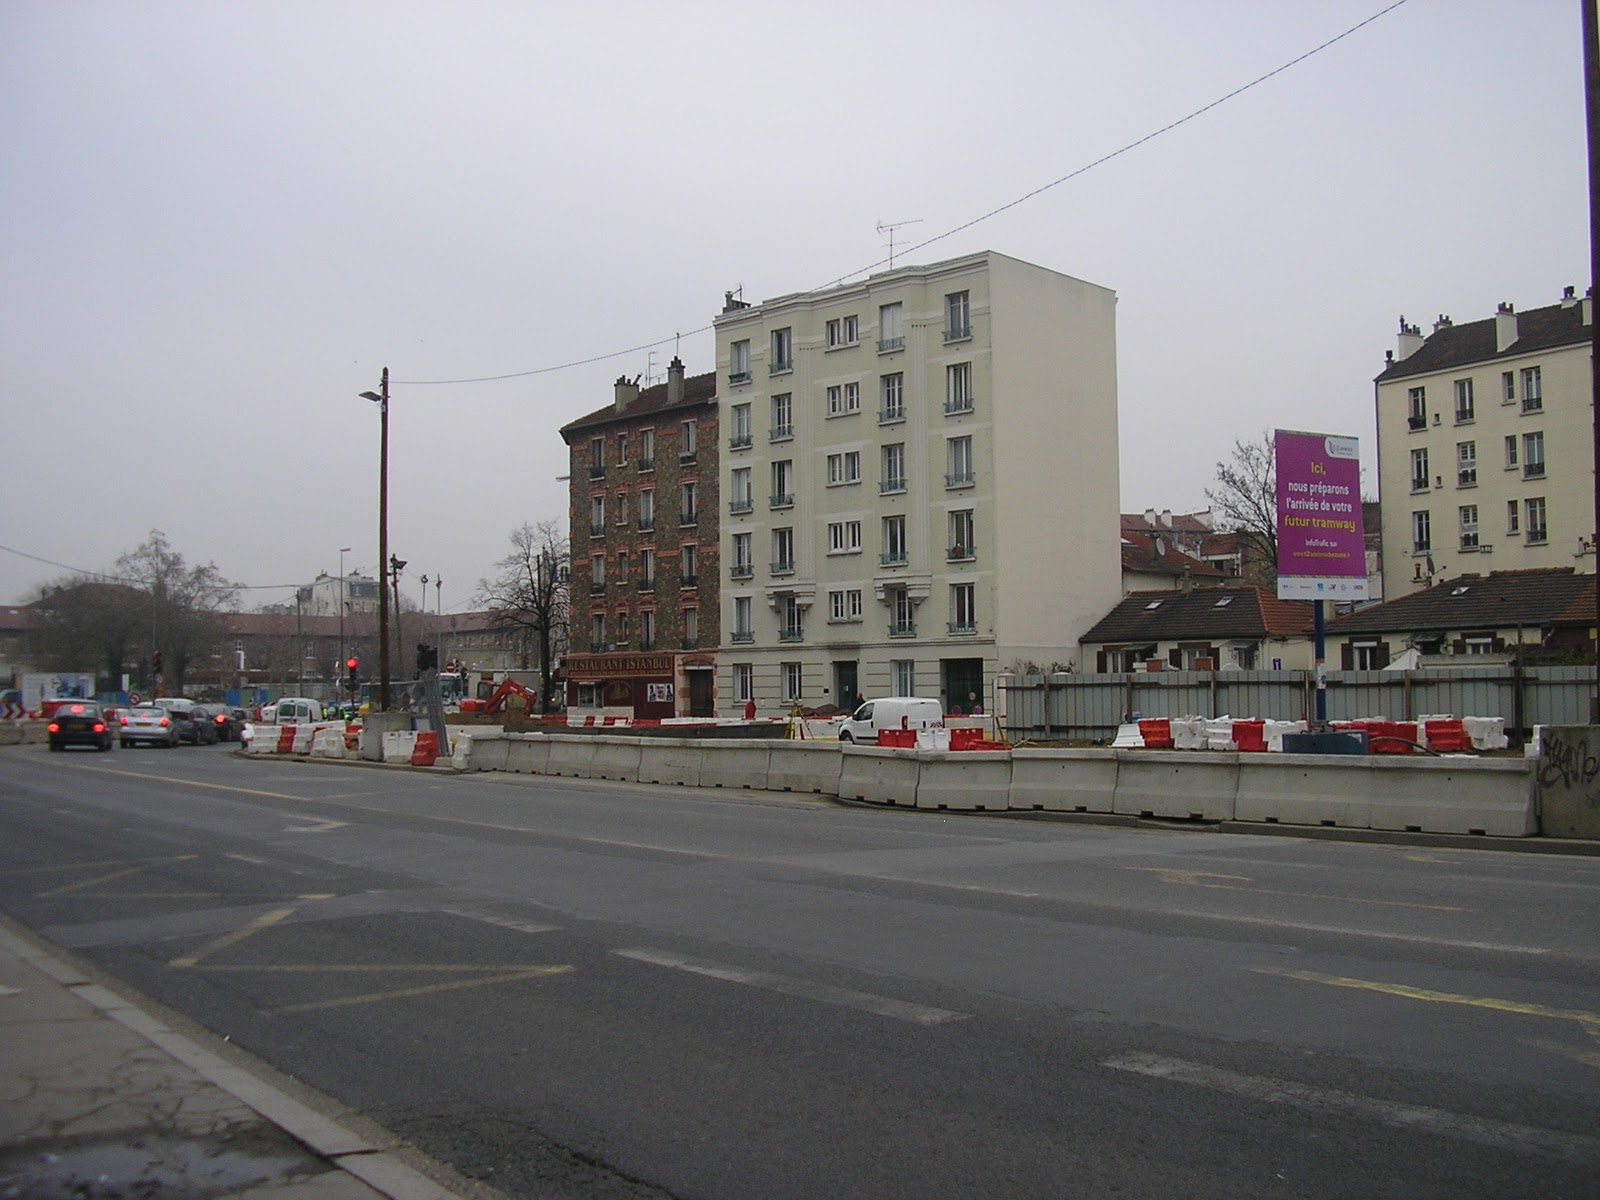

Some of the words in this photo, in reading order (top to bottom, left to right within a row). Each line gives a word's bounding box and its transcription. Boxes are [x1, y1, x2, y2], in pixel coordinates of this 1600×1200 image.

[1311, 462, 1326, 475] Ici,
[1288, 482, 1308, 492] nous
[1310, 481, 1349, 497] préparons
[1286, 496, 1319, 511] l'arrivée
[1320, 499, 1331, 511] de
[1331, 501, 1352, 513] votre
[1284, 515, 1310, 526] futur
[1312, 517, 1355, 532] tramway
[568, 659, 623, 670] RESTAURANT
[627, 658, 669, 669] ISTANBUL
